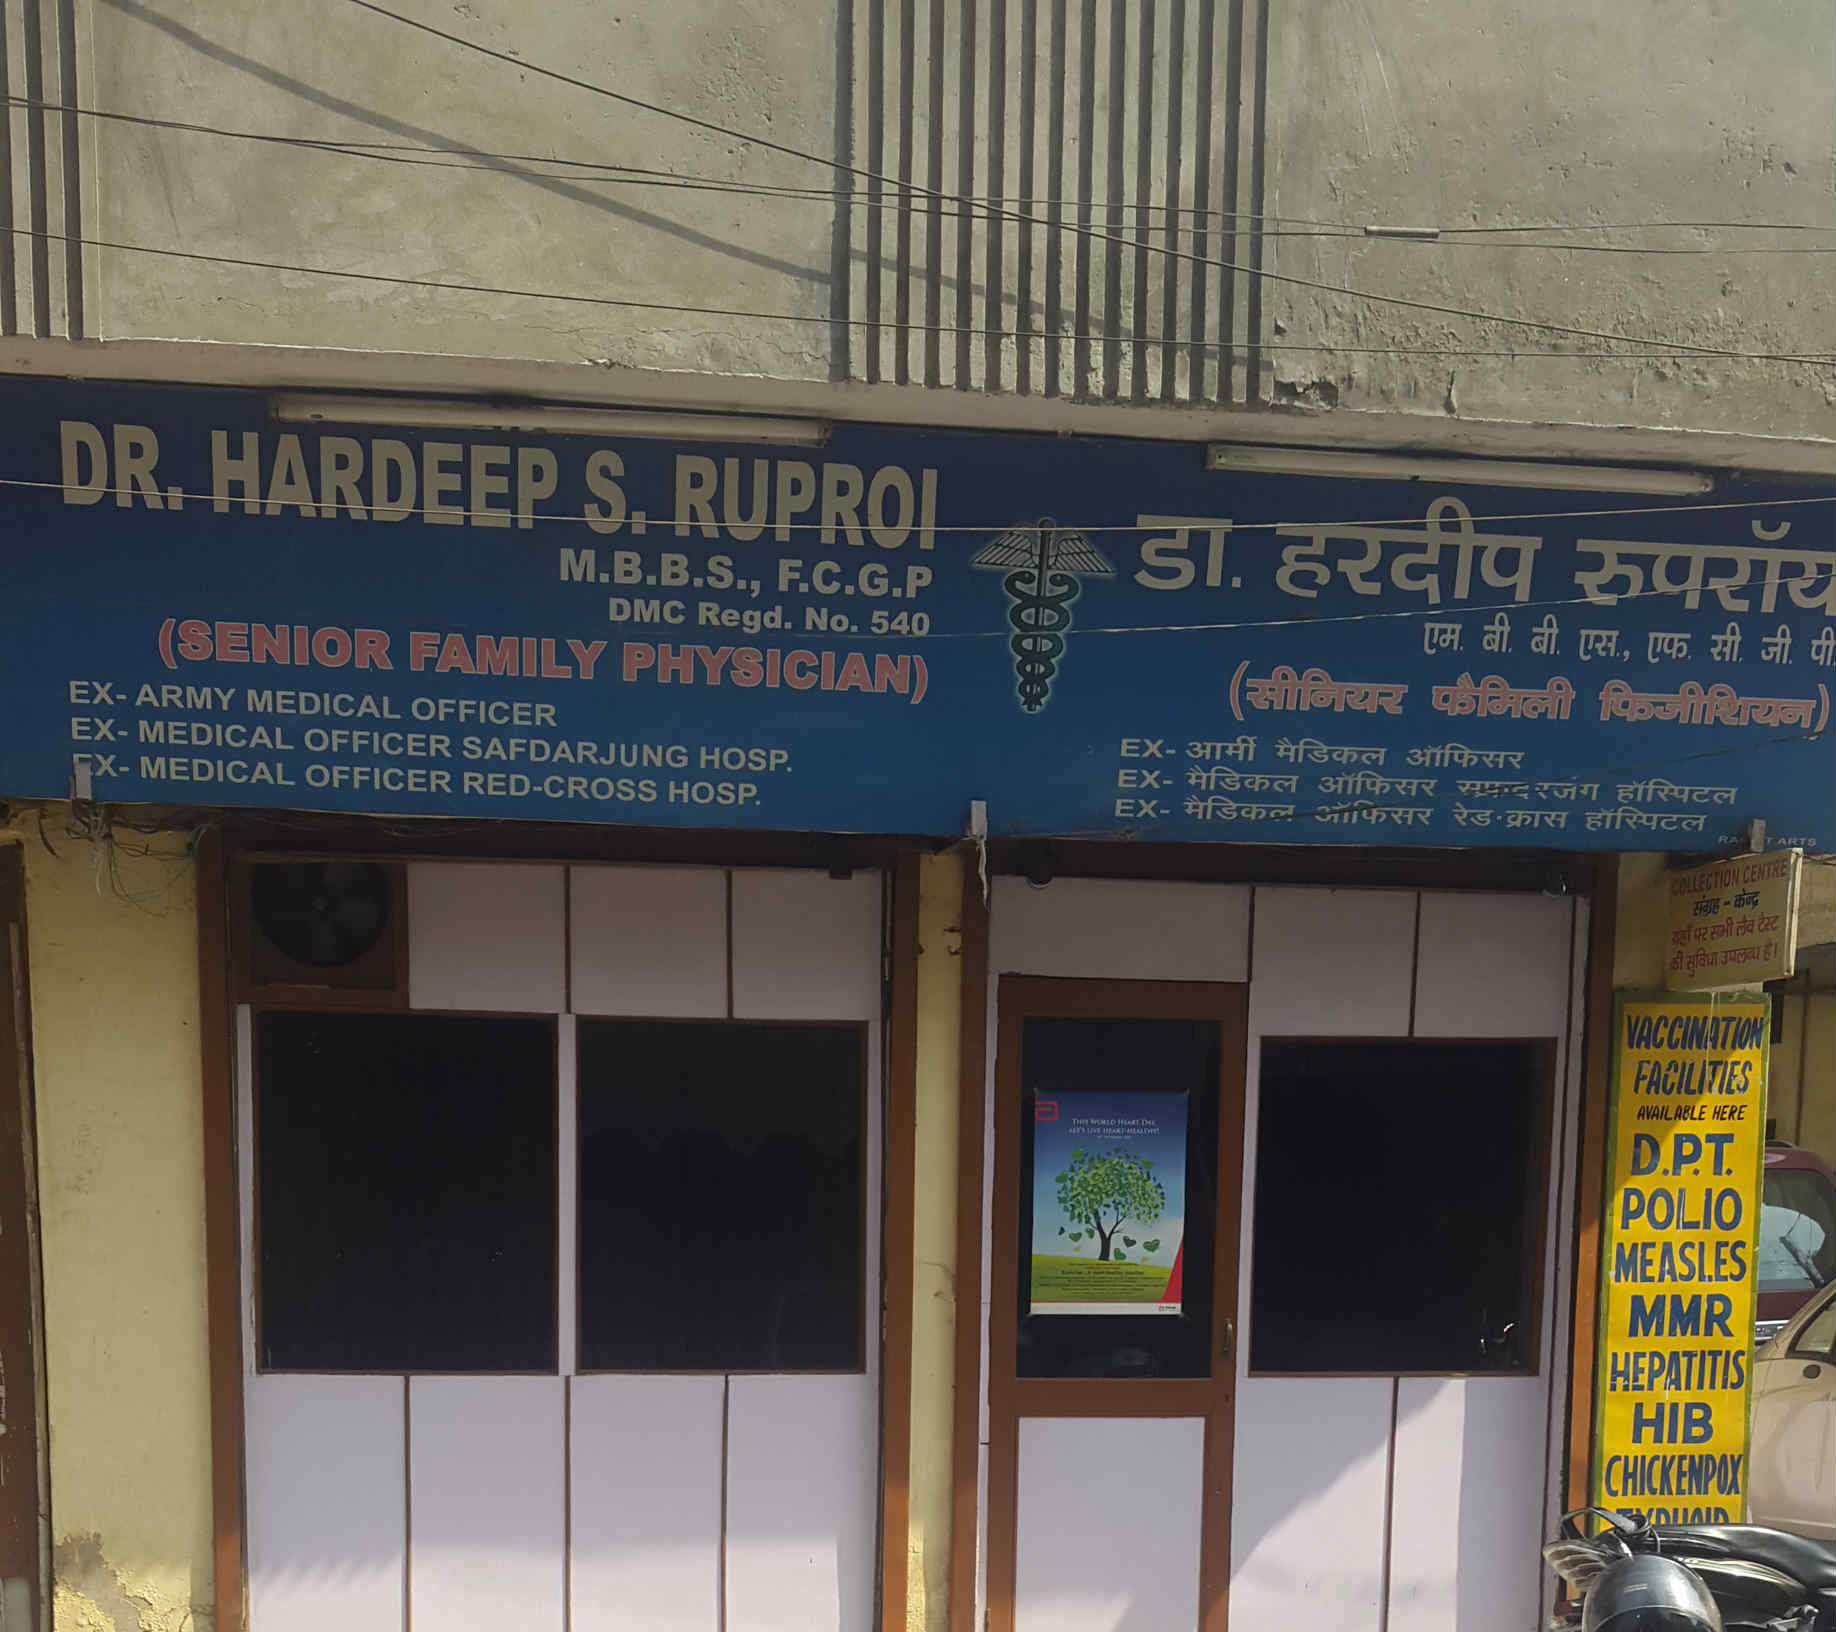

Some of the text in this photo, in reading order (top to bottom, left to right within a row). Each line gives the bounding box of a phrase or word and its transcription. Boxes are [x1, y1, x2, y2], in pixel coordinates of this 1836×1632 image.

[60, 421, 938, 550] DR. HARDEEP S. RUPROI
[1134, 514, 1242, 590] डा.
[1275, 496, 1542, 605] हरदीप
[560, 548, 933, 598] M.B.B.S., F.C.G.P
[608, 598, 930, 636] DMC Regd. No. 540
[1423, 622, 1464, 656] एम.
[1483, 612, 1512, 653] बी.
[1531, 614, 1560, 655] बी.
[1711, 622, 1742, 662] सी.
[1761, 624, 1793, 665] जी.
[158, 618, 929, 704] (SENIOR FAMILY PHYSICIAN)
[69, 681, 557, 727] EX- ARMY MEDICAL OFFICER
[1229, 660, 1409, 721] (सीनियर
[1432, 672, 1576, 719] फैमिली
[71, 717, 793, 773] EX- MEDICAL OFFICER SAFDARJUNG HOSP.
[1120, 738, 1177, 759] EX-
[1274, 737, 1388, 767] मैडिकल
[140, 756, 296, 786] MEDICAL
[305, 764, 453, 794] OFFICER
[463, 770, 657, 802] RED-CROSS
[668, 780, 761, 805] HOSP.
[1117, 769, 1173, 789] EX-
[1114, 799, 1170, 819] EX-
[1743, 857, 1788, 884] CENTRE
[1627, 1015, 1765, 1051] VACCINATION
[1633, 1060, 1753, 1096] FACILITIES
[1637, 1104, 1748, 1121] AVAILABLE HERE
[1631, 1133, 1734, 1176] D.P.T.
[1620, 1187, 1743, 1231] POLIO
[1614, 1240, 1747, 1284] MEASLES
[1628, 1293, 1735, 1338] MMR
[1610, 1350, 1747, 1392] HEPATITIS
[1631, 1402, 1714, 1445] HIB
[1605, 1453, 1744, 1497] CHICKENPOX
